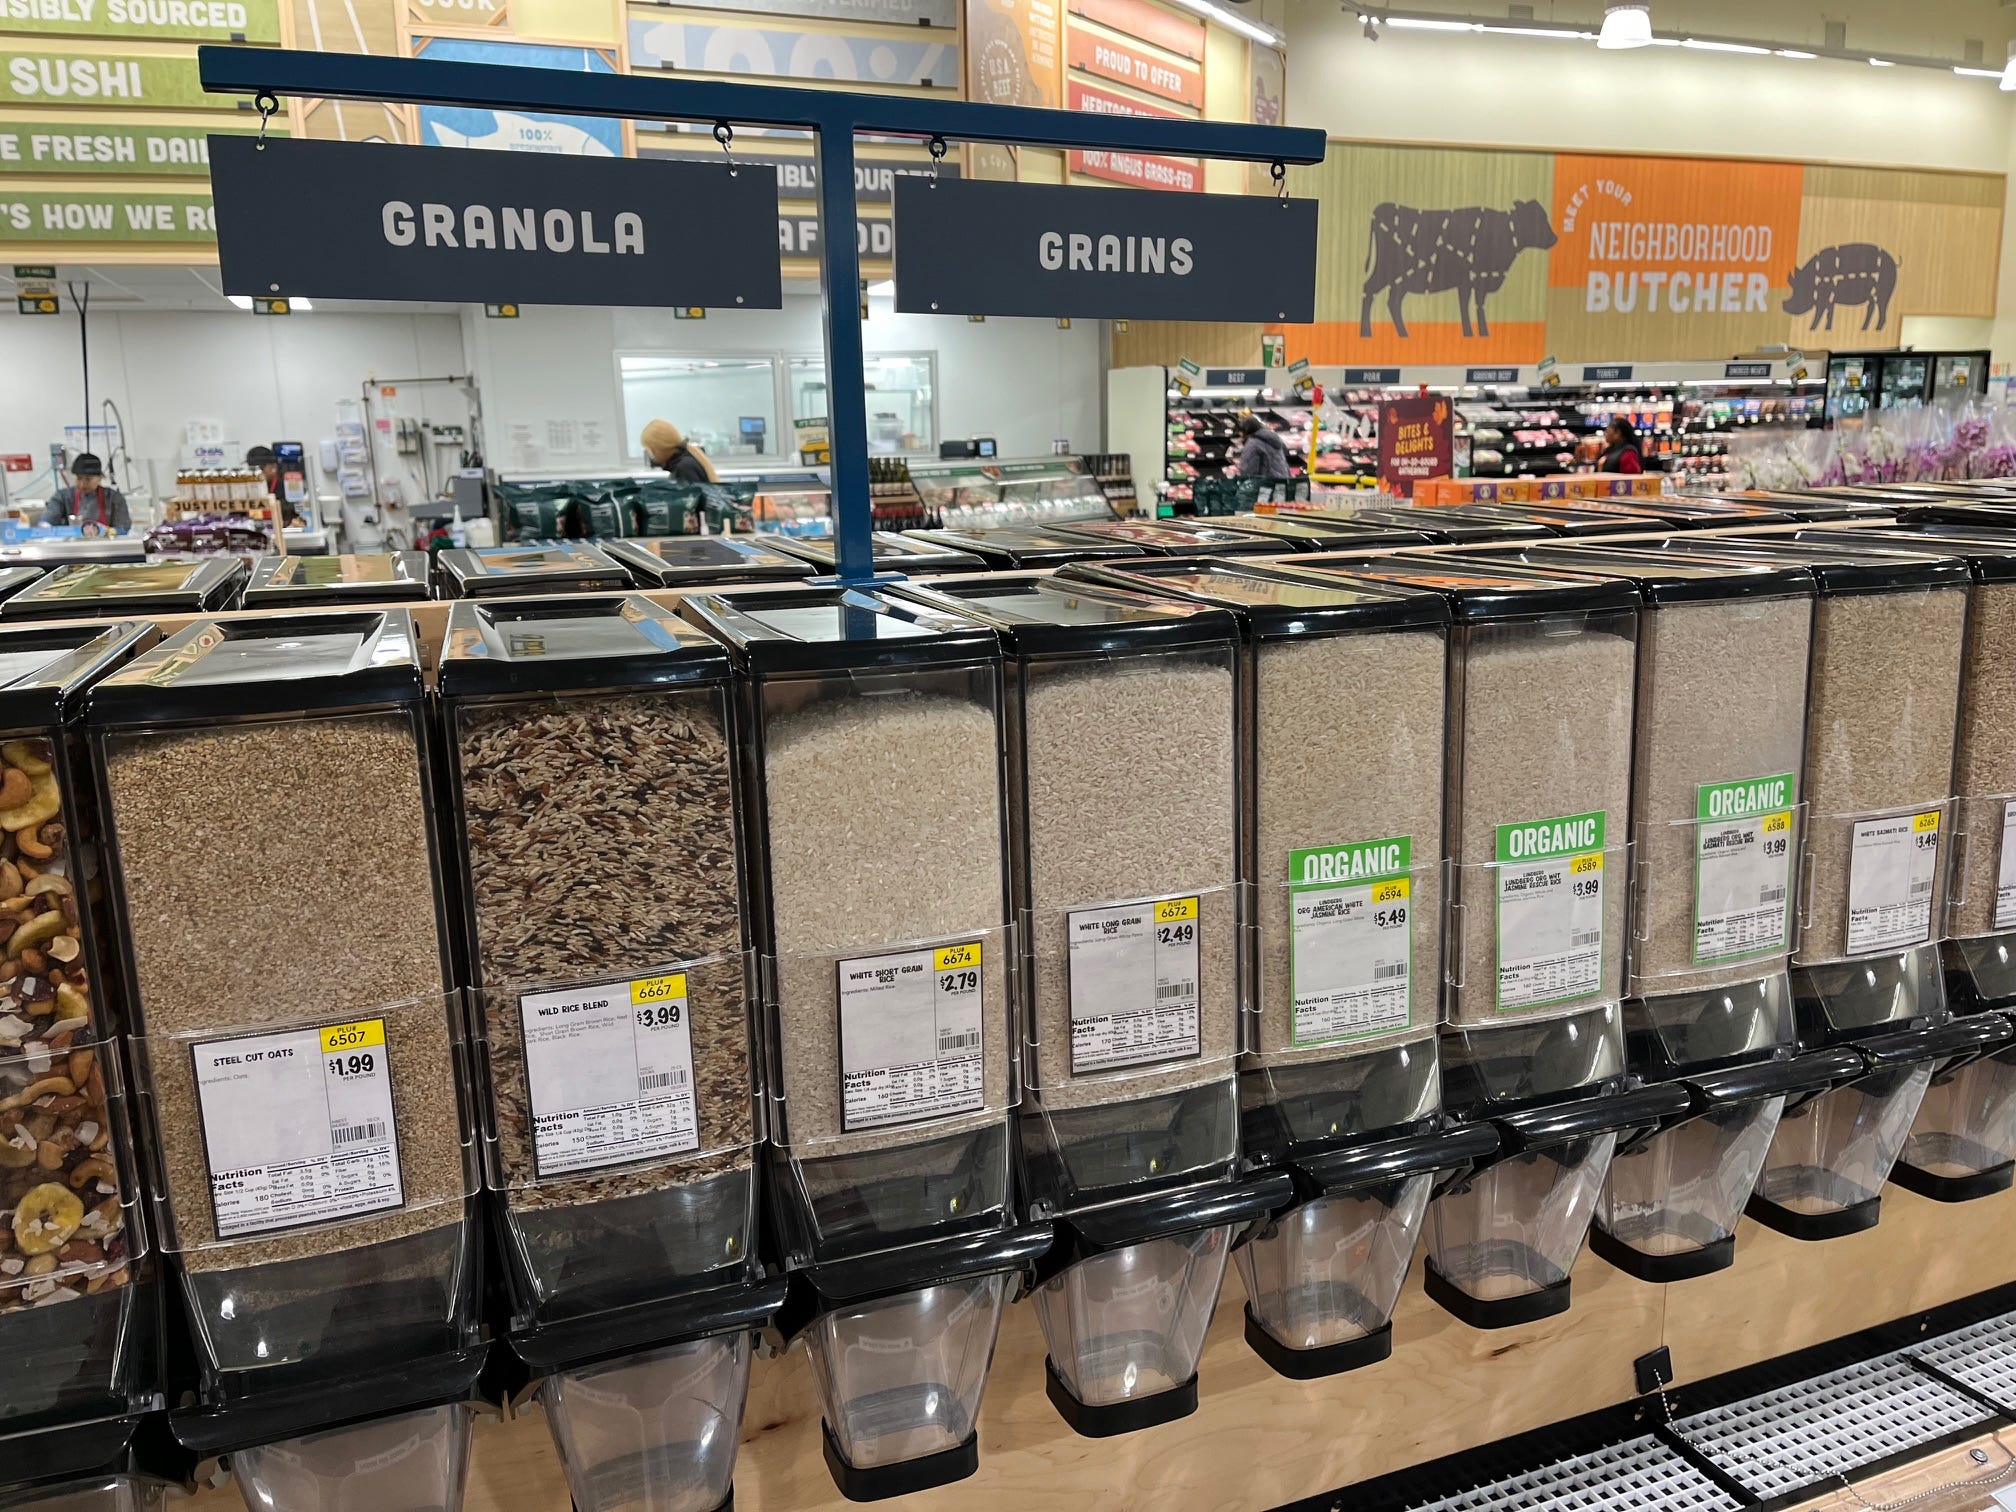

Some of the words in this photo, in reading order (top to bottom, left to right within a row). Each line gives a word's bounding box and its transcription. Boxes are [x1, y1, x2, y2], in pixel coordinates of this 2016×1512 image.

[108, 0, 247, 28] SOURCED
[1095, 46, 1130, 73] PROUD
[1135, 59, 1148, 80] TO
[1151, 65, 1182, 93] OFFER
[9, 57, 142, 97] SUSHI
[520, 129, 552, 140] 100%
[31, 134, 136, 162] FRESH
[1082, 150, 1107, 168] 100%
[1110, 154, 1143, 175] ANGUS
[1145, 164, 1194, 189] GRASS-FED
[1563, 184, 1589, 233] MEET
[1596, 179, 1632, 206] YOUR
[42, 203, 114, 230] HOW
[125, 204, 175, 230] WE
[382, 201, 645, 255] GRANOLA
[1589, 221, 1772, 262] NEIGHBORHOOD
[1039, 231, 1194, 276] GRAINS
[1585, 271, 1769, 313] BUTCHER
[1227, 373, 1245, 383] BEEF
[1363, 371, 1381, 382] PORK
[1398, 423, 1421, 440] BITES
[1423, 422, 1430, 436] &
[1395, 437, 1434, 455] DELIGHTS
[175, 501, 209, 511] JUST
[213, 501, 237, 510] ICE
[241, 501, 265, 511] TEA
[1709, 780, 1785, 817] ORGANIC
[1509, 818, 1596, 858] ORGANIC
[1916, 832, 1937, 848] $3.49
[1763, 838, 1786, 855] $3.99
[1303, 844, 1400, 883] ORGANIC
[1577, 861, 1597, 873] 6589
[1505, 876, 1534, 886] LUNDBERG
[1535, 874, 1548, 882] ORG
[1548, 872, 1561, 880] WHT
[1504, 884, 1528, 892] JASMINE
[1529, 881, 1549, 889] RESCUE
[1573, 879, 1599, 896] $3.99
[1379, 890, 1402, 901] 6594
[1161, 906, 1187, 918] 6672
[1297, 907, 1311, 915] ORG
[1312, 903, 1343, 913] AMERICAN
[1344, 900, 1363, 909] WHITE
[1310, 911, 1336, 919] JASMINE
[1337, 908, 1351, 916] RICE
[1851, 907, 1878, 916] Nutrition
[1079, 922, 1099, 931] WHITE
[1101, 920, 1119, 928] LONG
[1121, 917, 1142, 926] GRAIN
[1373, 908, 1406, 927] $5.49
[1697, 918, 1724, 927] Nutrition
[1103, 927, 1118, 935] RICE
[1157, 925, 1193, 944] $2.49
[943, 952, 971, 965] 6674
[849, 971, 873, 981] WHITE
[875, 967, 899, 977] SHORT
[901, 964, 923, 974] GRAIN
[1500, 964, 1531, 973] Nutrition
[646, 979, 664, 987] PLU#
[879, 975, 895, 983] RICE
[940, 972, 977, 992] $2.79
[639, 985, 672, 999] 6667
[1295, 996, 1329, 1006] Nutrition
[538, 1007, 559, 1017] WILD
[561, 1004, 580, 1014] RICE
[582, 1000, 609, 1011] BLEND
[1295, 1006, 1317, 1014] Facts
[636, 1005, 680, 1027] $3.99
[1072, 1016, 1109, 1027] Nutrition
[337, 1025, 357, 1034] PLU#
[570, 1025, 587, 1033] Brown
[660, 1023, 680, 1031] POUND
[1072, 1026, 1096, 1035] Facts
[329, 1031, 366, 1047] 6507
[213, 1056, 242, 1067] STEEL
[245, 1052, 263, 1063] CUT
[267, 1048, 294, 1060] OATS
[329, 1053, 374, 1077] $1.99
[354, 1072, 376, 1080] POUND
[844, 1069, 886, 1081] Nutrition
[844, 1080, 871, 1089] Facts
[844, 1096, 867, 1104] Calories
[533, 1112, 579, 1124] Nutrition
[534, 1123, 564, 1133] Facts
[572, 1136, 585, 1144] 150
[211, 1168, 263, 1182] Nutrition
[212, 1181, 245, 1191] Facts
[255, 1194, 270, 1203] 180
